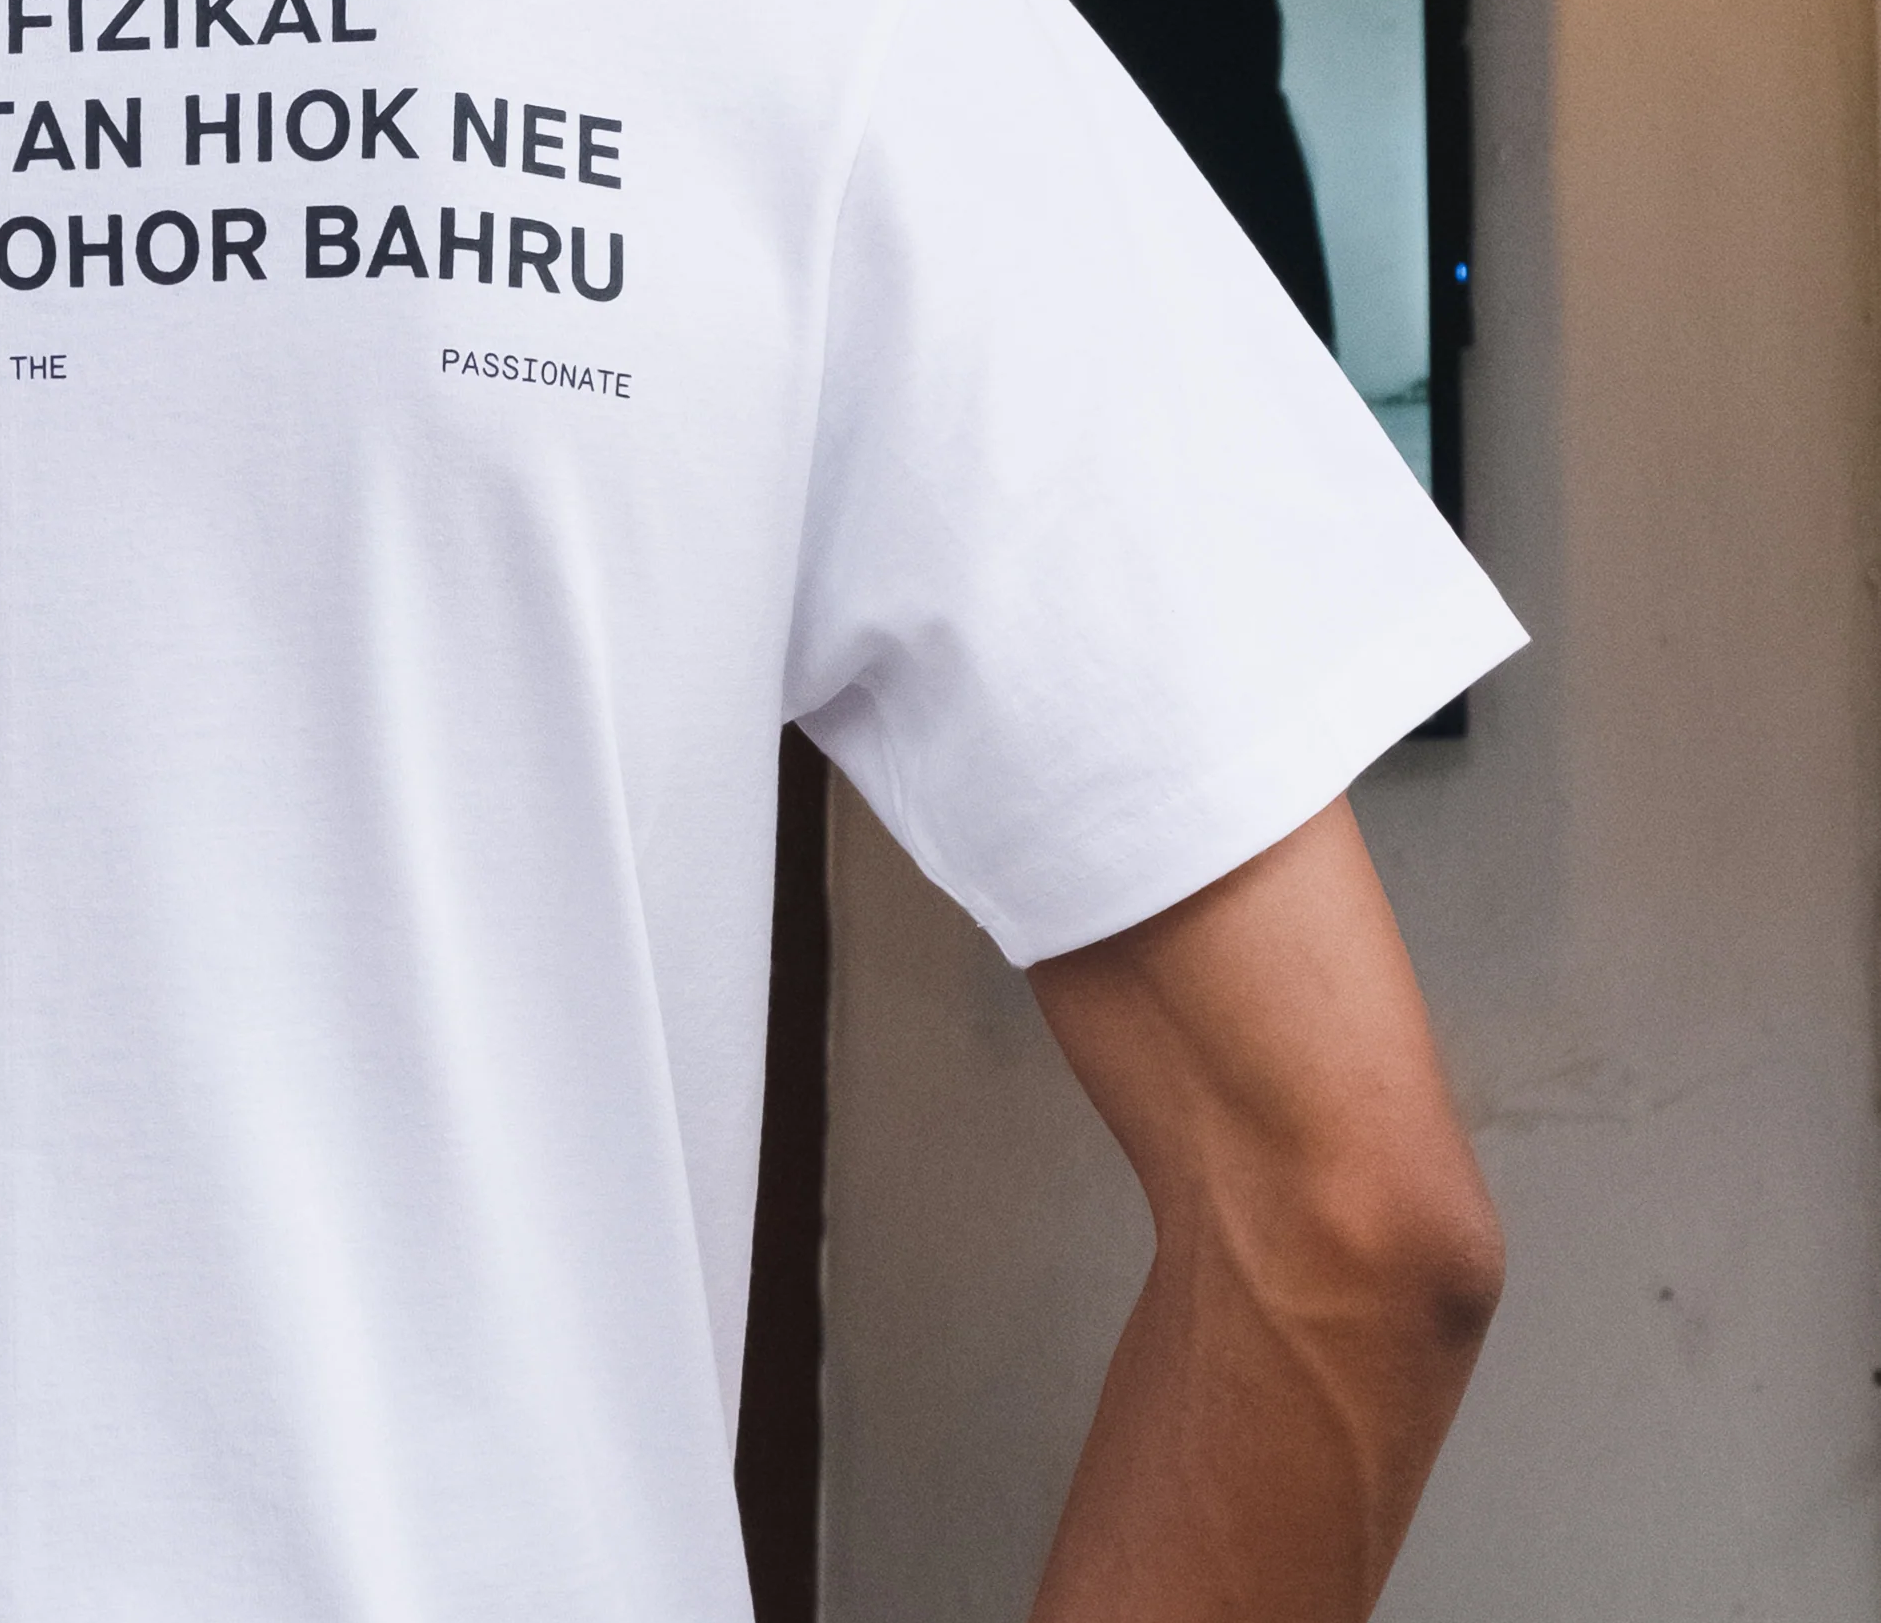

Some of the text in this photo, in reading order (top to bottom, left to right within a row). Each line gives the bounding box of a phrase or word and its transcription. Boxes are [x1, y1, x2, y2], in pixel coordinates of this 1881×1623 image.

[184, 87, 420, 166] HIOK
[452, 91, 623, 190] NEE
[305, 204, 624, 303] BAHRU
[9, 354, 68, 381] THE
[442, 348, 632, 399] PASSIONATE
